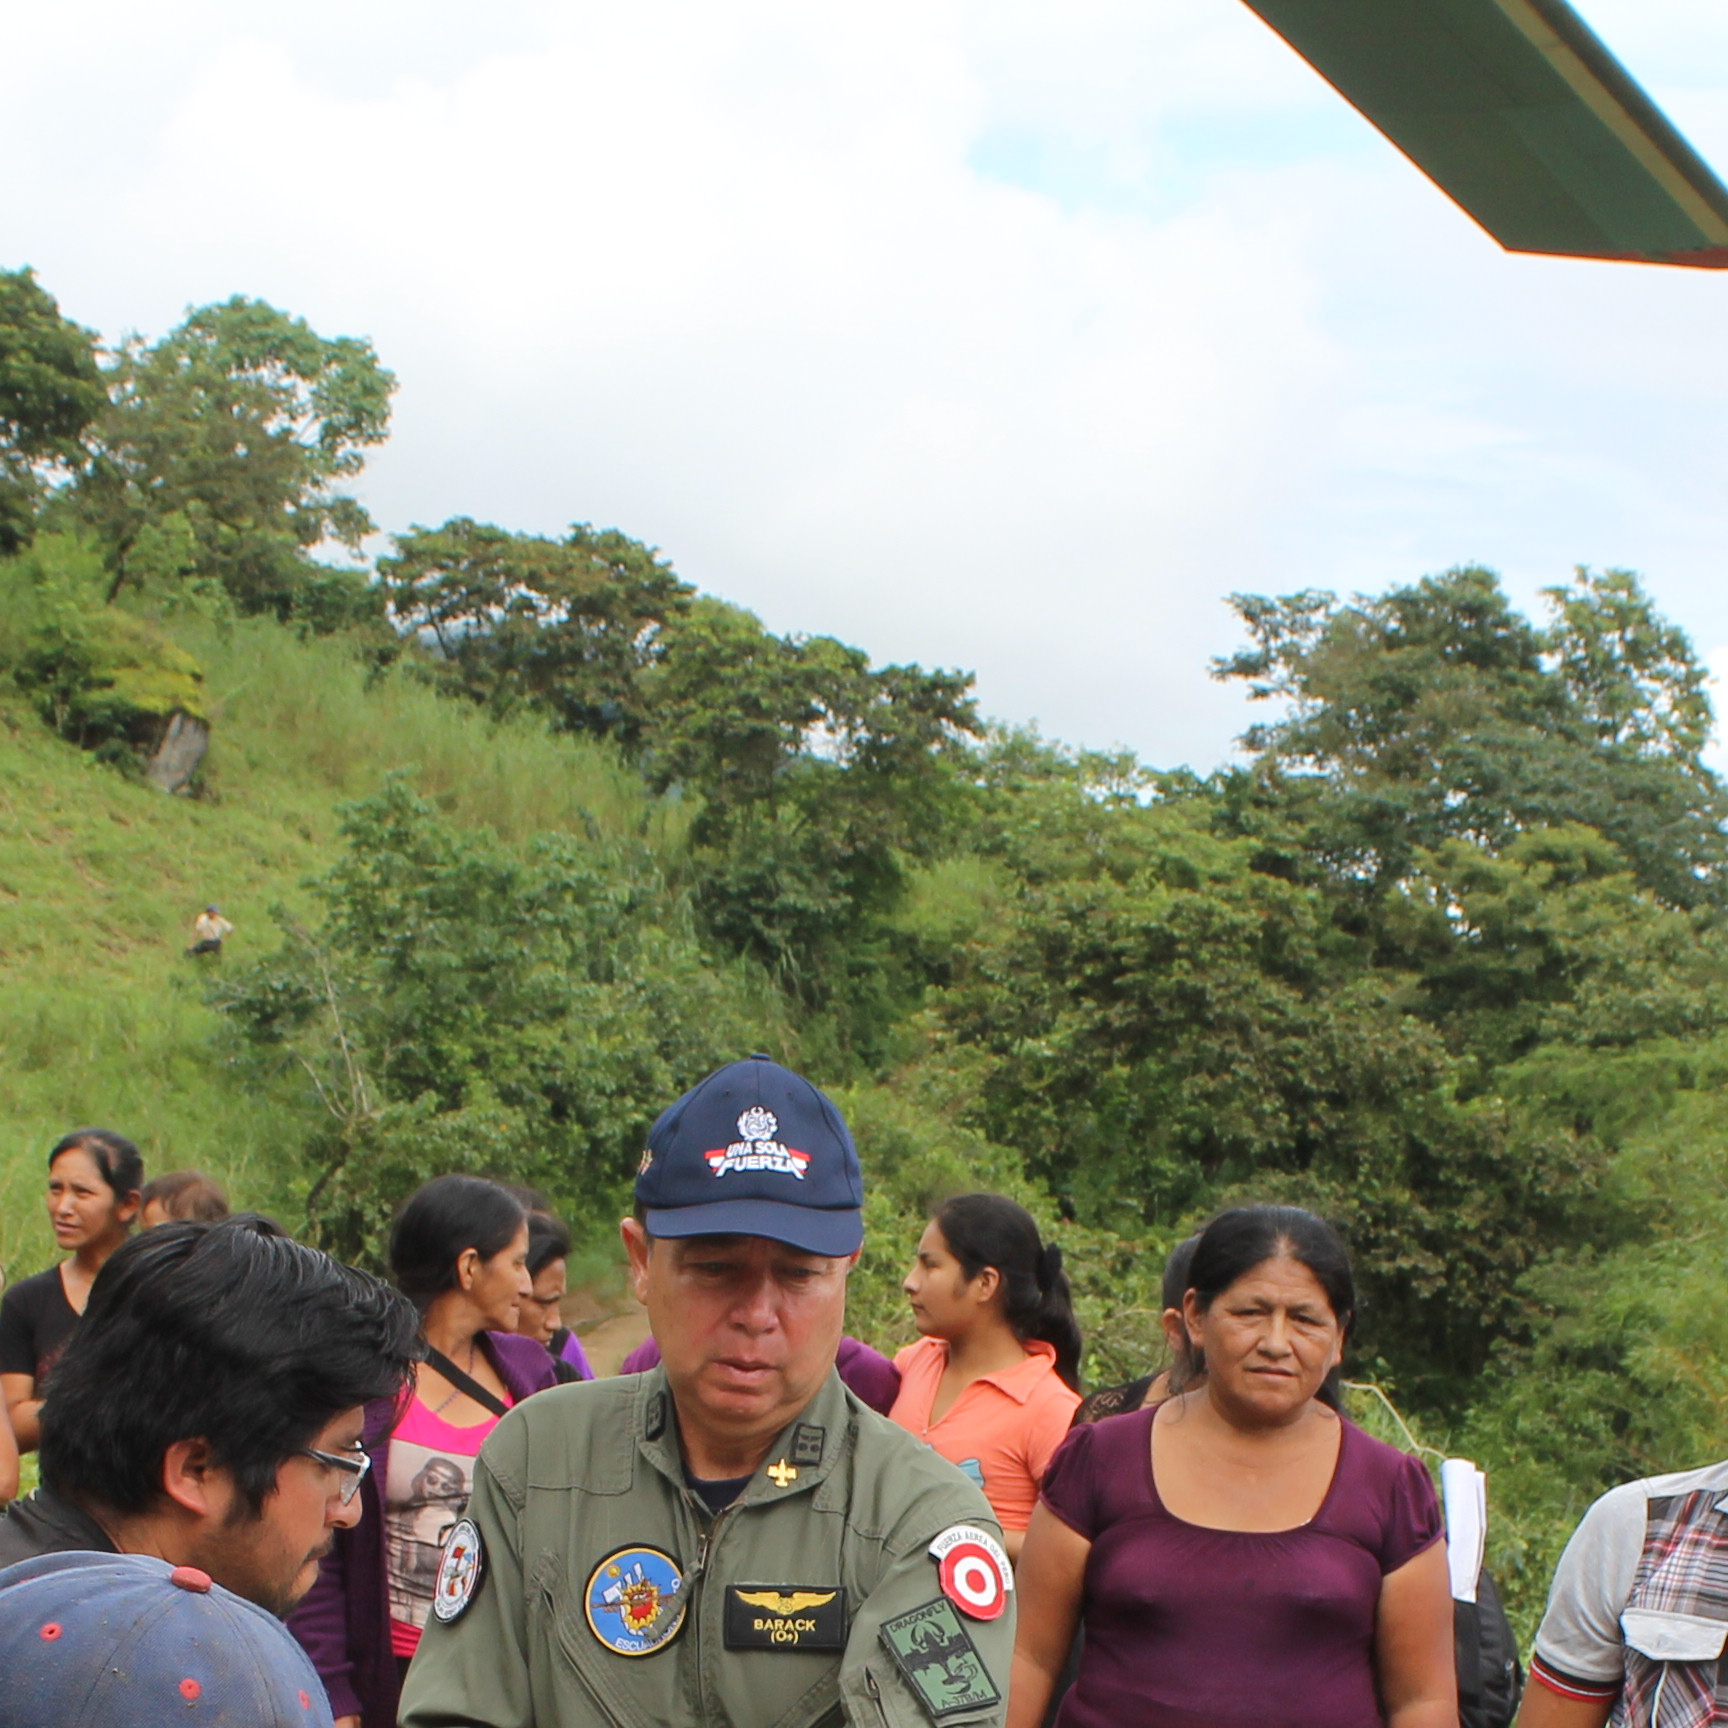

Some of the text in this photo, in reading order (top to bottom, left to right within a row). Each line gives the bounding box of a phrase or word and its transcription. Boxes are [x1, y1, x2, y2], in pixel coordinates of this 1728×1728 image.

[726, 1141, 791, 1158] UNA SOLA
[716, 1155, 804, 1180] FUERZA
[753, 1618, 816, 1632] BARACK
[889, 1602, 947, 1633] DRAGONFLY
